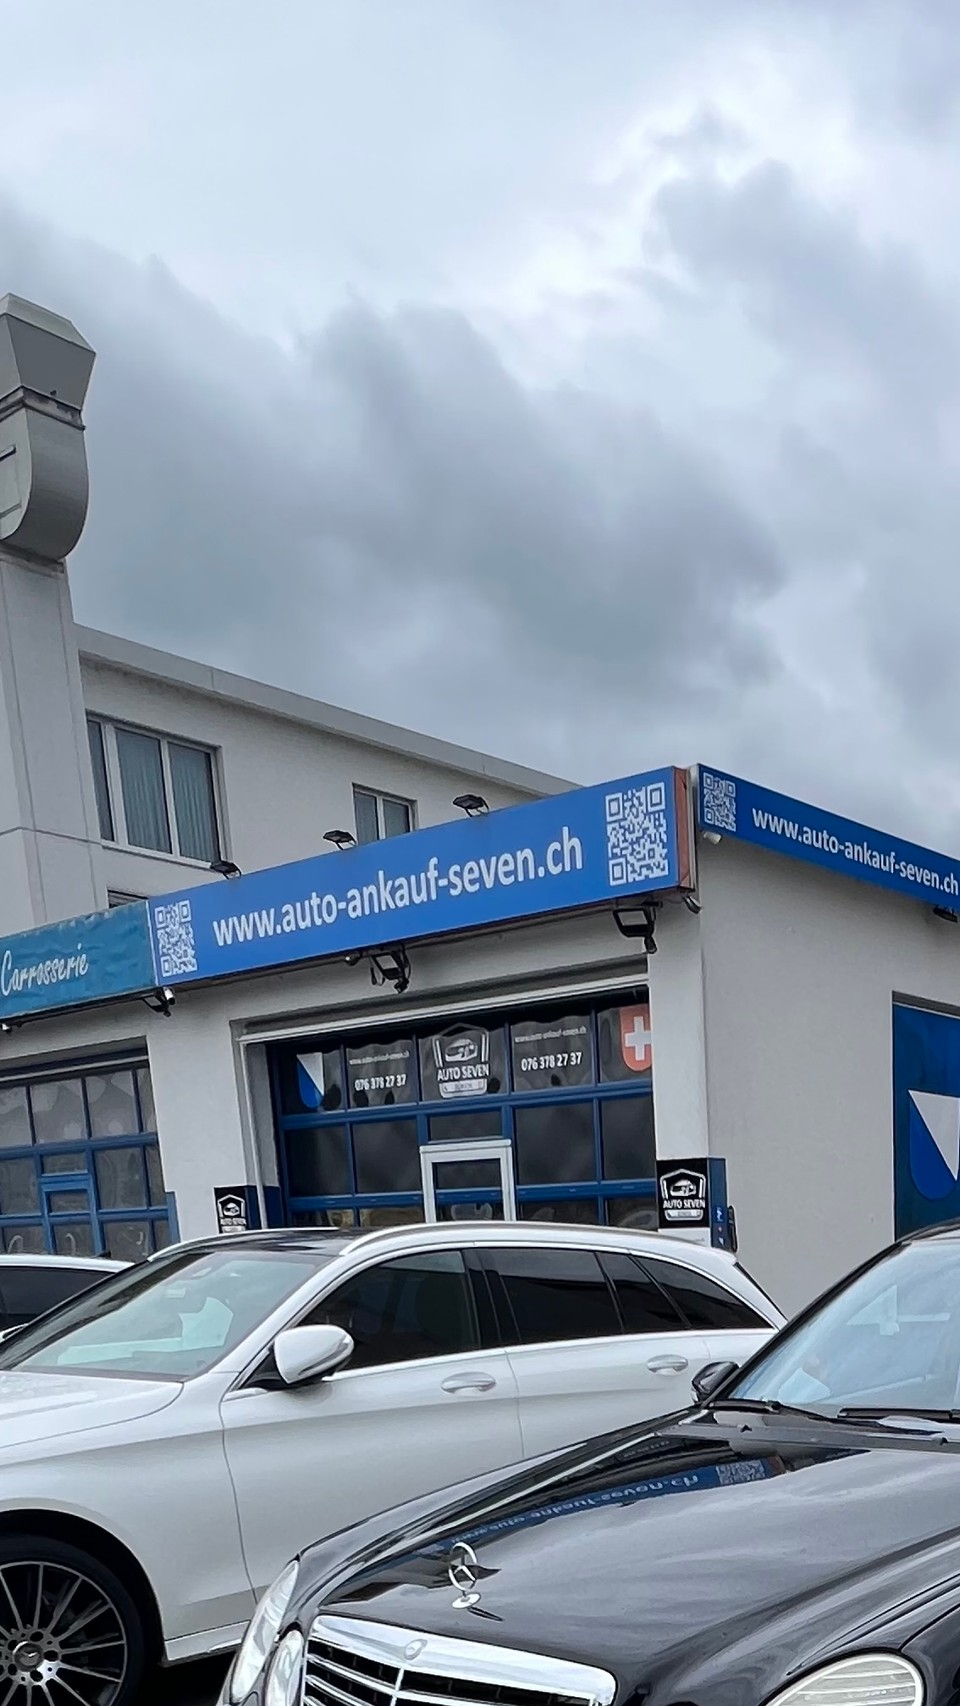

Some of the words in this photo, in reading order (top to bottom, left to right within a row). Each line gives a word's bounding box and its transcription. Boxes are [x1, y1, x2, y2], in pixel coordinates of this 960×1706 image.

[752, 807, 960, 896] www.auto-ankauf-seven.ch
[211, 826, 584, 947] www.auto-ankauf-seven.ch
[0, 942, 89, 996] Carrosserie
[437, 1066, 460, 1081] AUTO
[462, 1064, 489, 1079] SEVEN
[521, 1057, 538, 1071] 076
[539, 1055, 555, 1068] 378
[557, 1053, 569, 1067] 27
[570, 1052, 582, 1065] 37
[662, 1199, 682, 1209] AUTO
[684, 1198, 706, 1209] SEVEN
